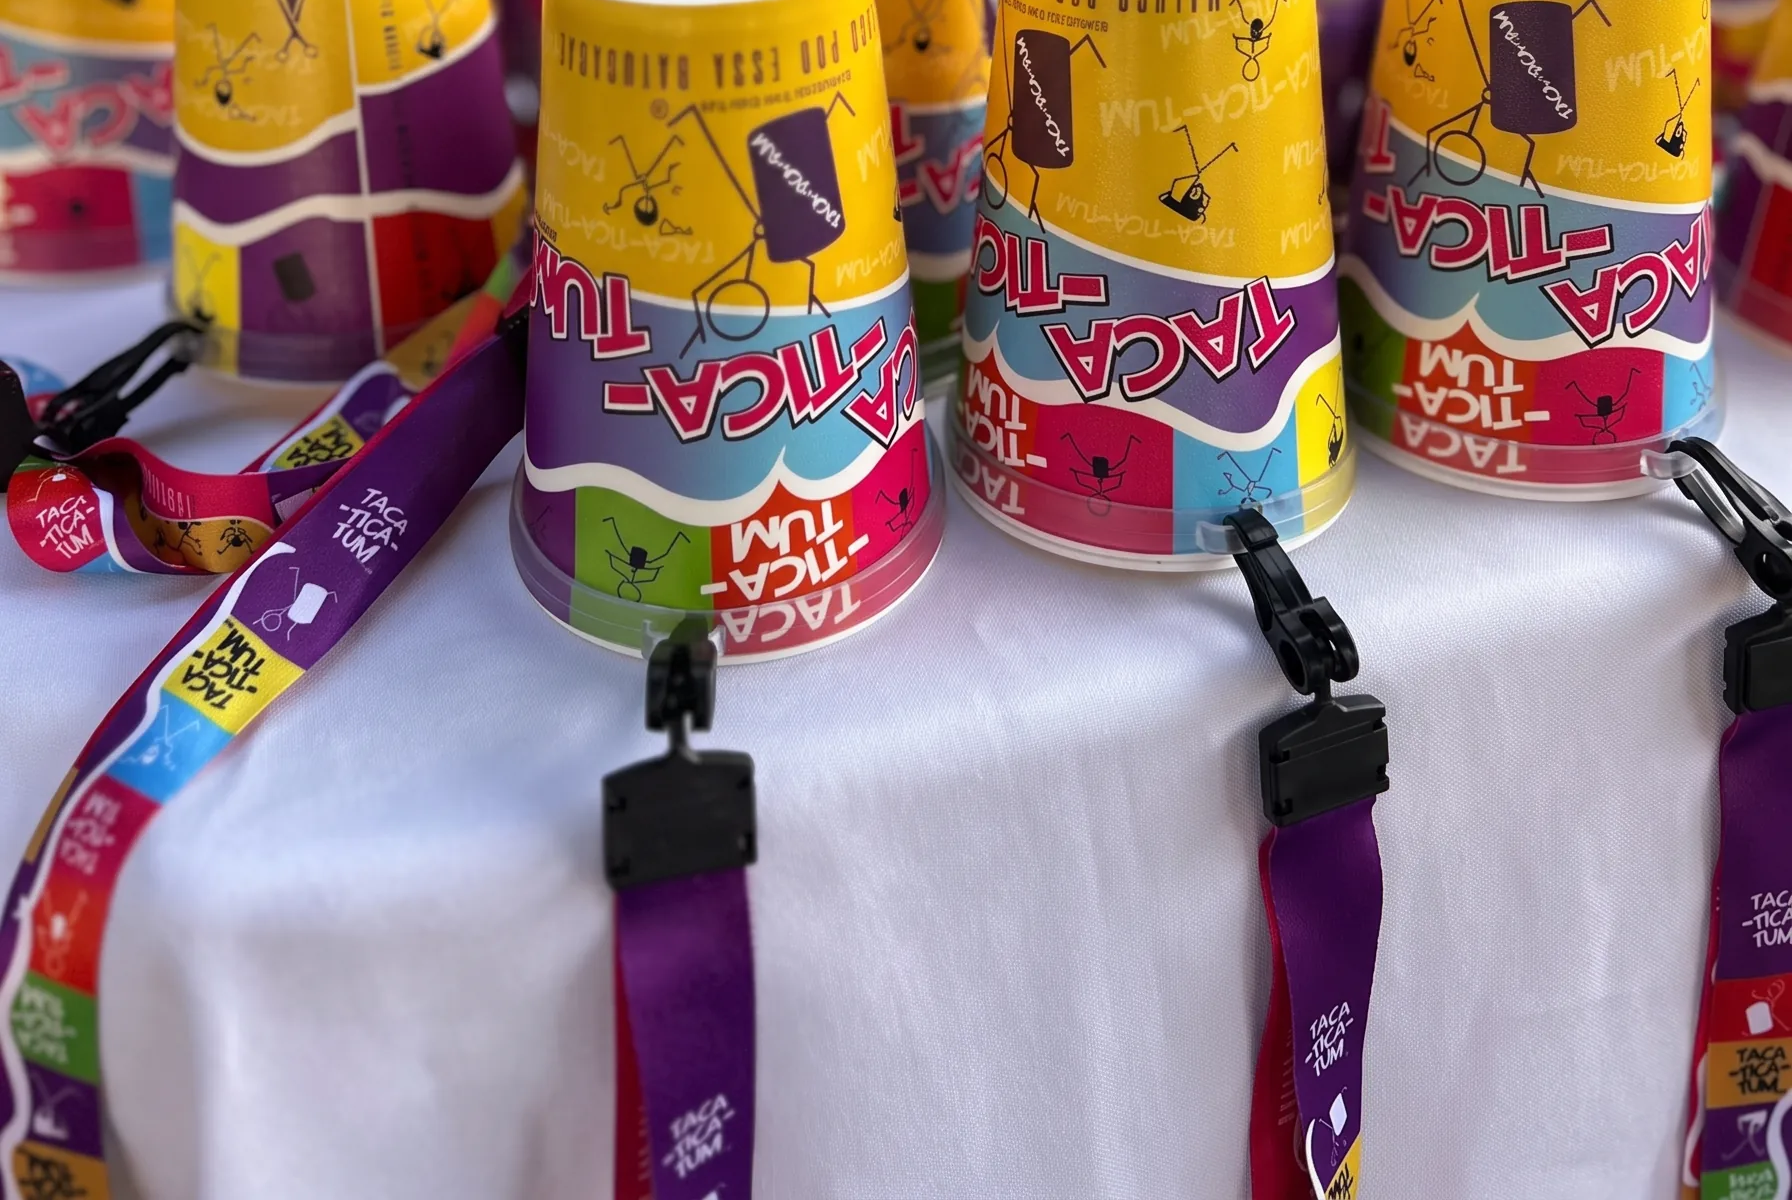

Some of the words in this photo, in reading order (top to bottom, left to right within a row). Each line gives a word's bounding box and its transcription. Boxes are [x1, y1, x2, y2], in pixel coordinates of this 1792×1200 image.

[1040, 276, 1296, 404] TACA
[1419, 341, 1525, 395] TUM
[968, 364, 1027, 430] TUM
[1391, 381, 1550, 430] -TICA-
[1400, 414, 1527, 474] TACA
[35, 495, 87, 528] TACA
[360, 488, 408, 536] TACA
[730, 499, 844, 563] TUM
[55, 523, 95, 559] TUM
[332, 522, 381, 563] TUM
[700, 533, 870, 600] -TICA-
[721, 581, 861, 644] TACA
[216, 628, 266, 676] TUM
[182, 664, 233, 710] TACA
[1310, 1001, 1350, 1039] TACA
[1313, 1039, 1345, 1077] TUM
